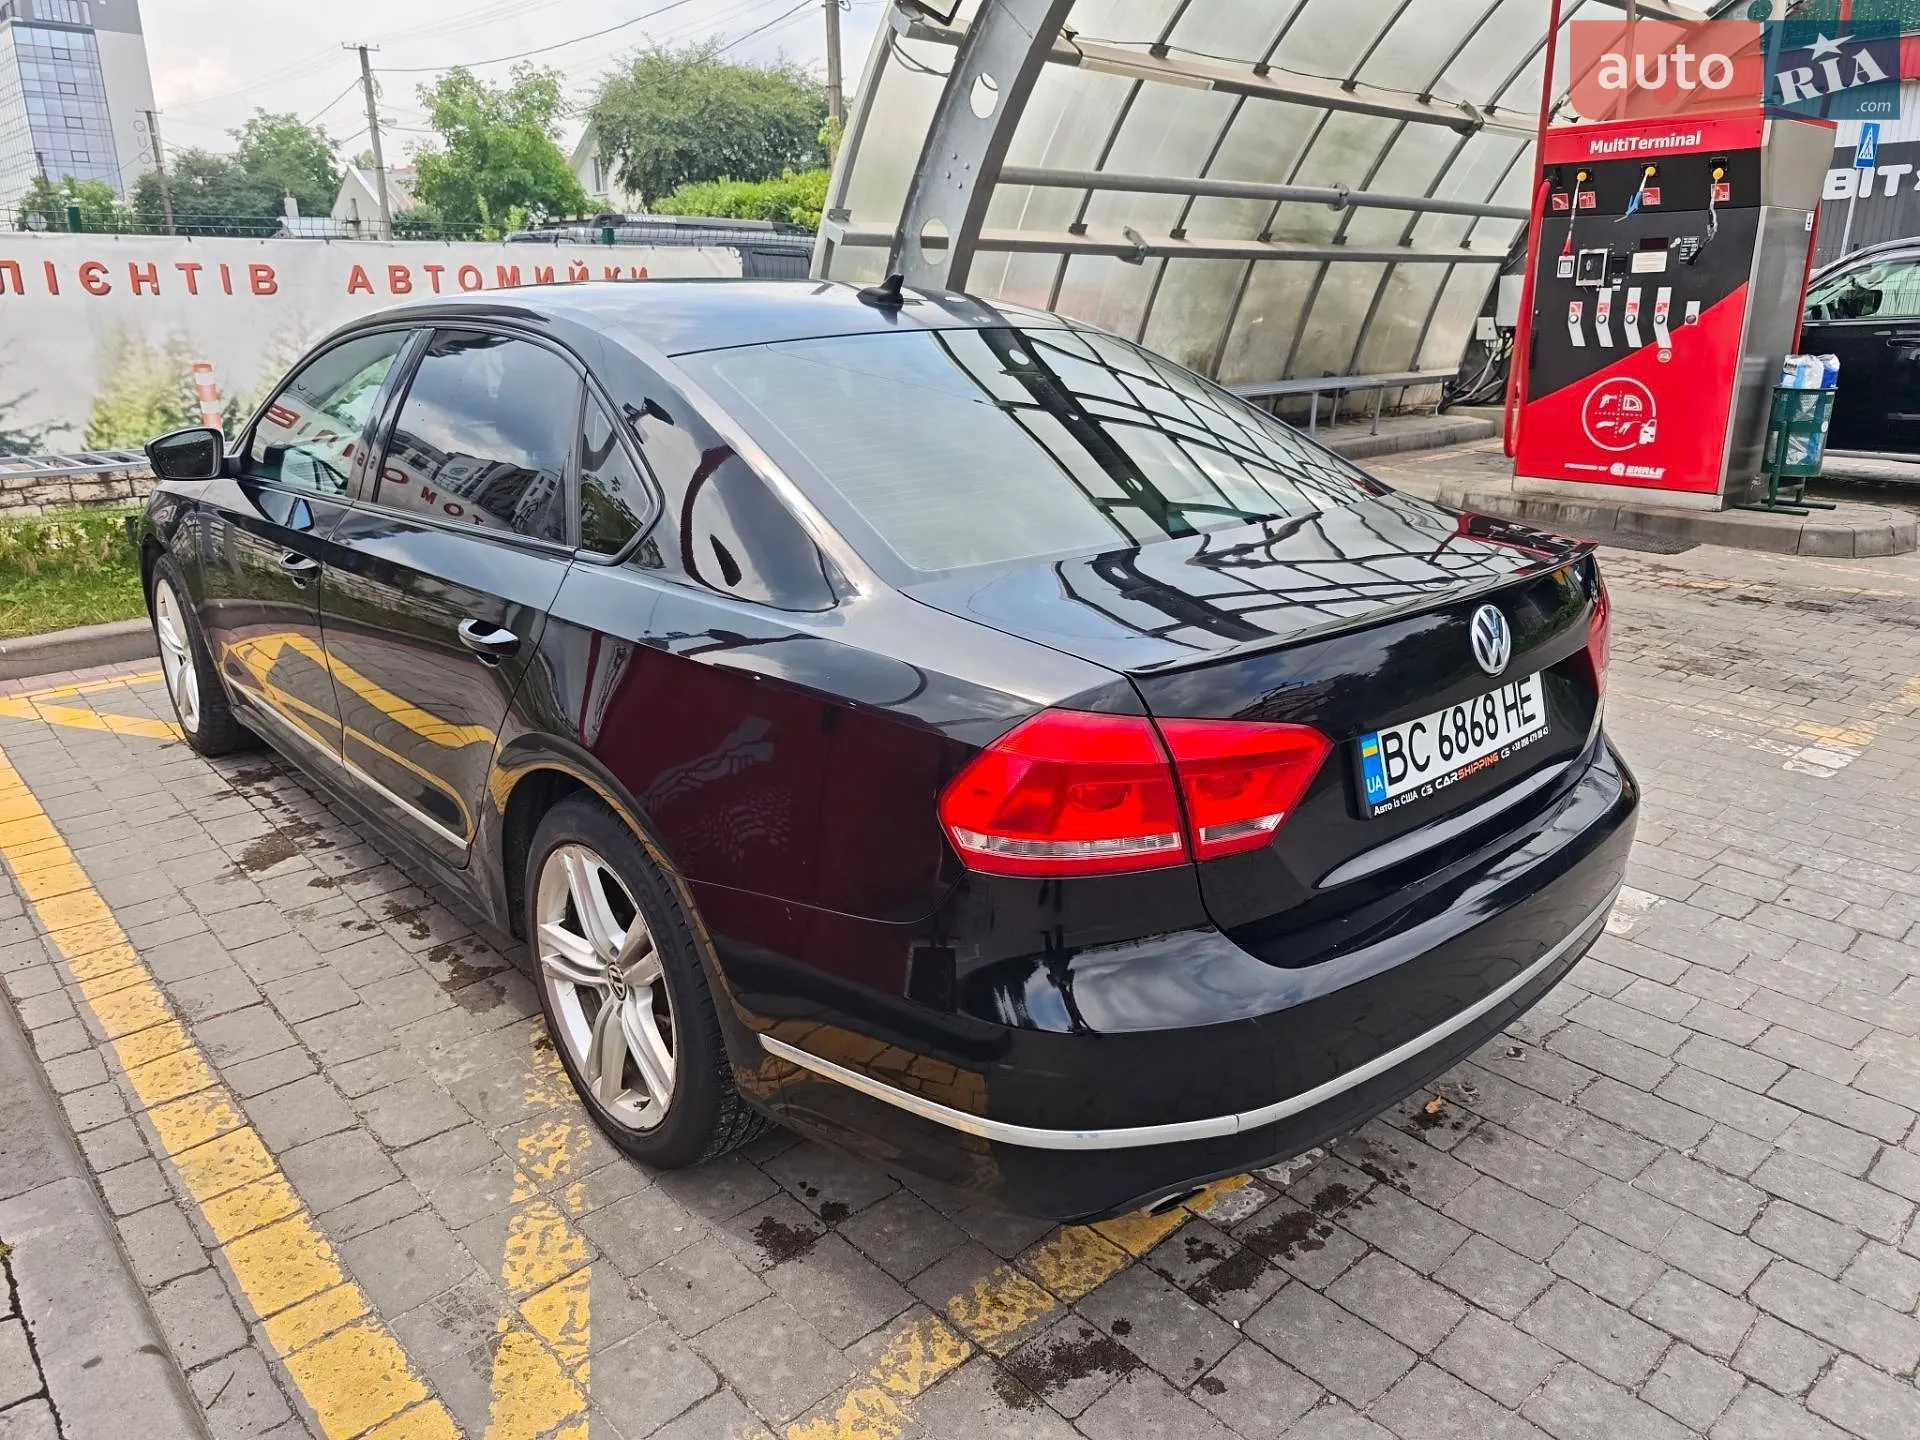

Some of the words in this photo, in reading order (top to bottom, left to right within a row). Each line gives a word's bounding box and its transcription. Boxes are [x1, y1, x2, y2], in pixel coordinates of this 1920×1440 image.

[1590, 130, 1702, 155] MultiTerminal
[1381, 721, 1430, 787] BC
[1438, 693, 1499, 761] 6868
[1501, 675, 1536, 734] HE
[1366, 774, 1383, 794] UA
[1374, 802, 1393, 816] Авто
[1400, 790, 1419, 805] США
[1435, 752, 1499, 789] CARSHIPPING
